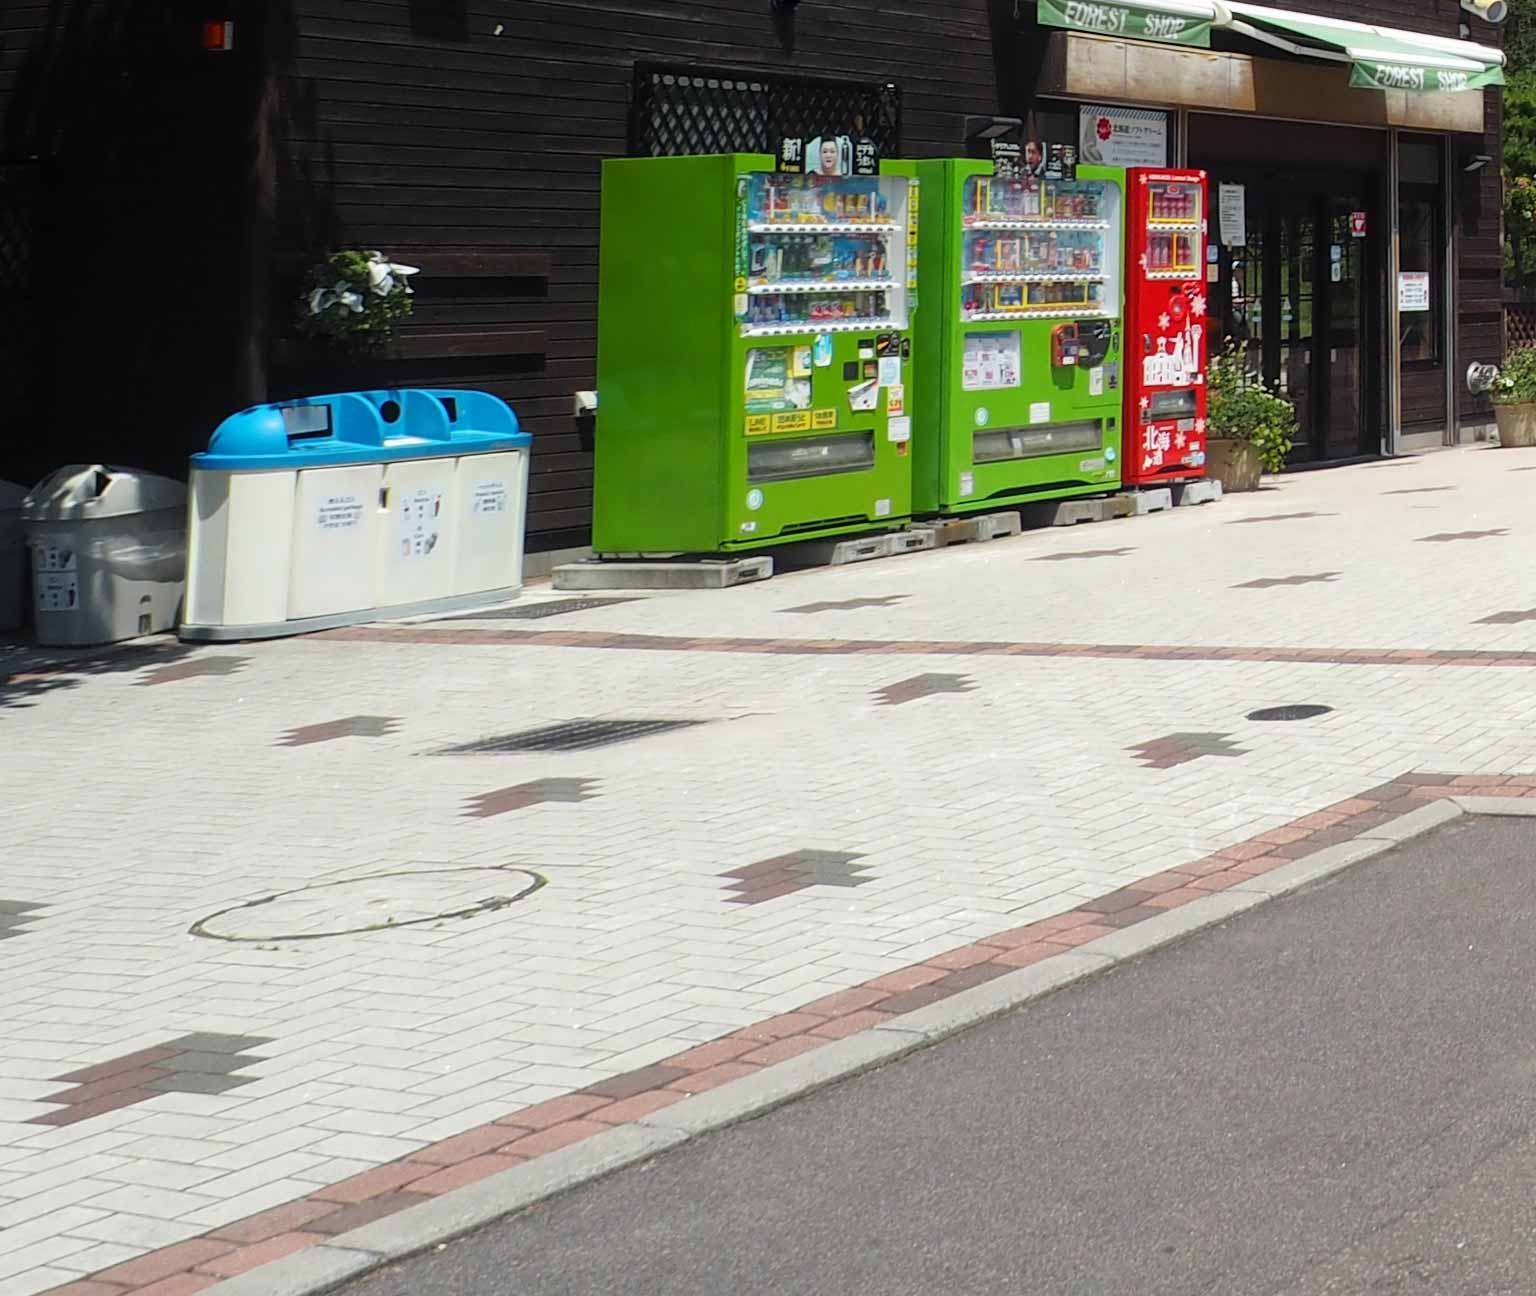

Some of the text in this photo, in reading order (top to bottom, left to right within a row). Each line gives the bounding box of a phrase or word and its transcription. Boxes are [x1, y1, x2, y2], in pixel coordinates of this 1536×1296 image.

[1065, 0, 1186, 40] FOREST SHOP
[1375, 64, 1468, 91] FOREST SHOP
